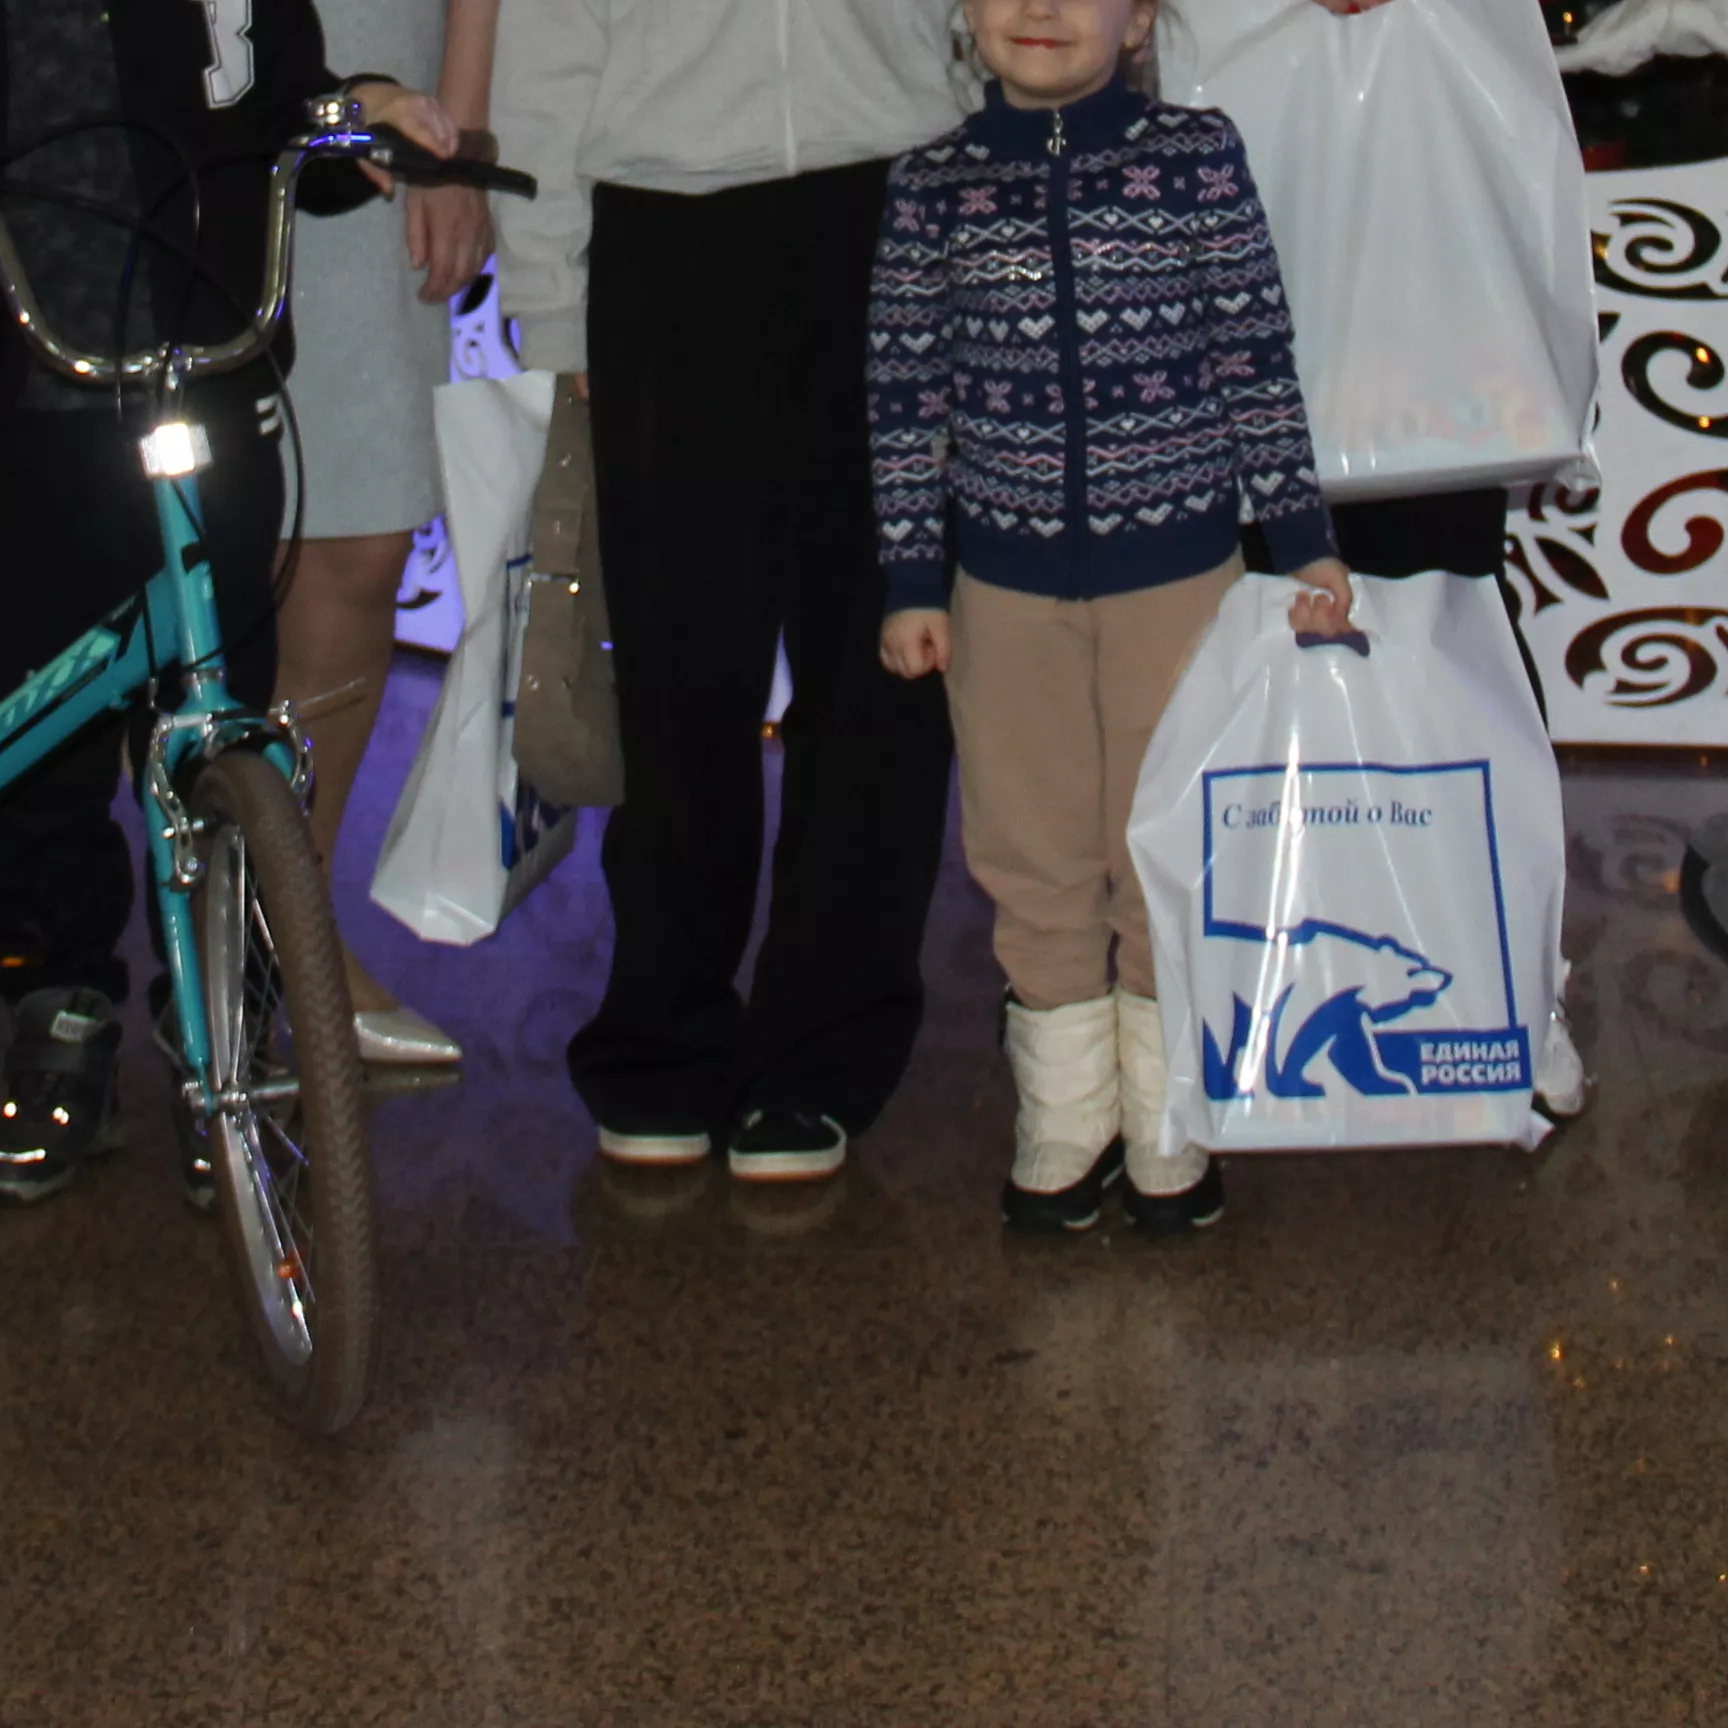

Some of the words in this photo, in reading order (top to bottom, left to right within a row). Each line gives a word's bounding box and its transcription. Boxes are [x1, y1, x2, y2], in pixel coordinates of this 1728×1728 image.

[1223, 803, 1242, 830] С
[1246, 798, 1359, 829] забтой
[1367, 806, 1382, 823] о
[1390, 800, 1432, 827] Вас
[1420, 1040, 1520, 1063] ЕДИНАЯ
[1421, 1061, 1522, 1086] РОССИЯ
